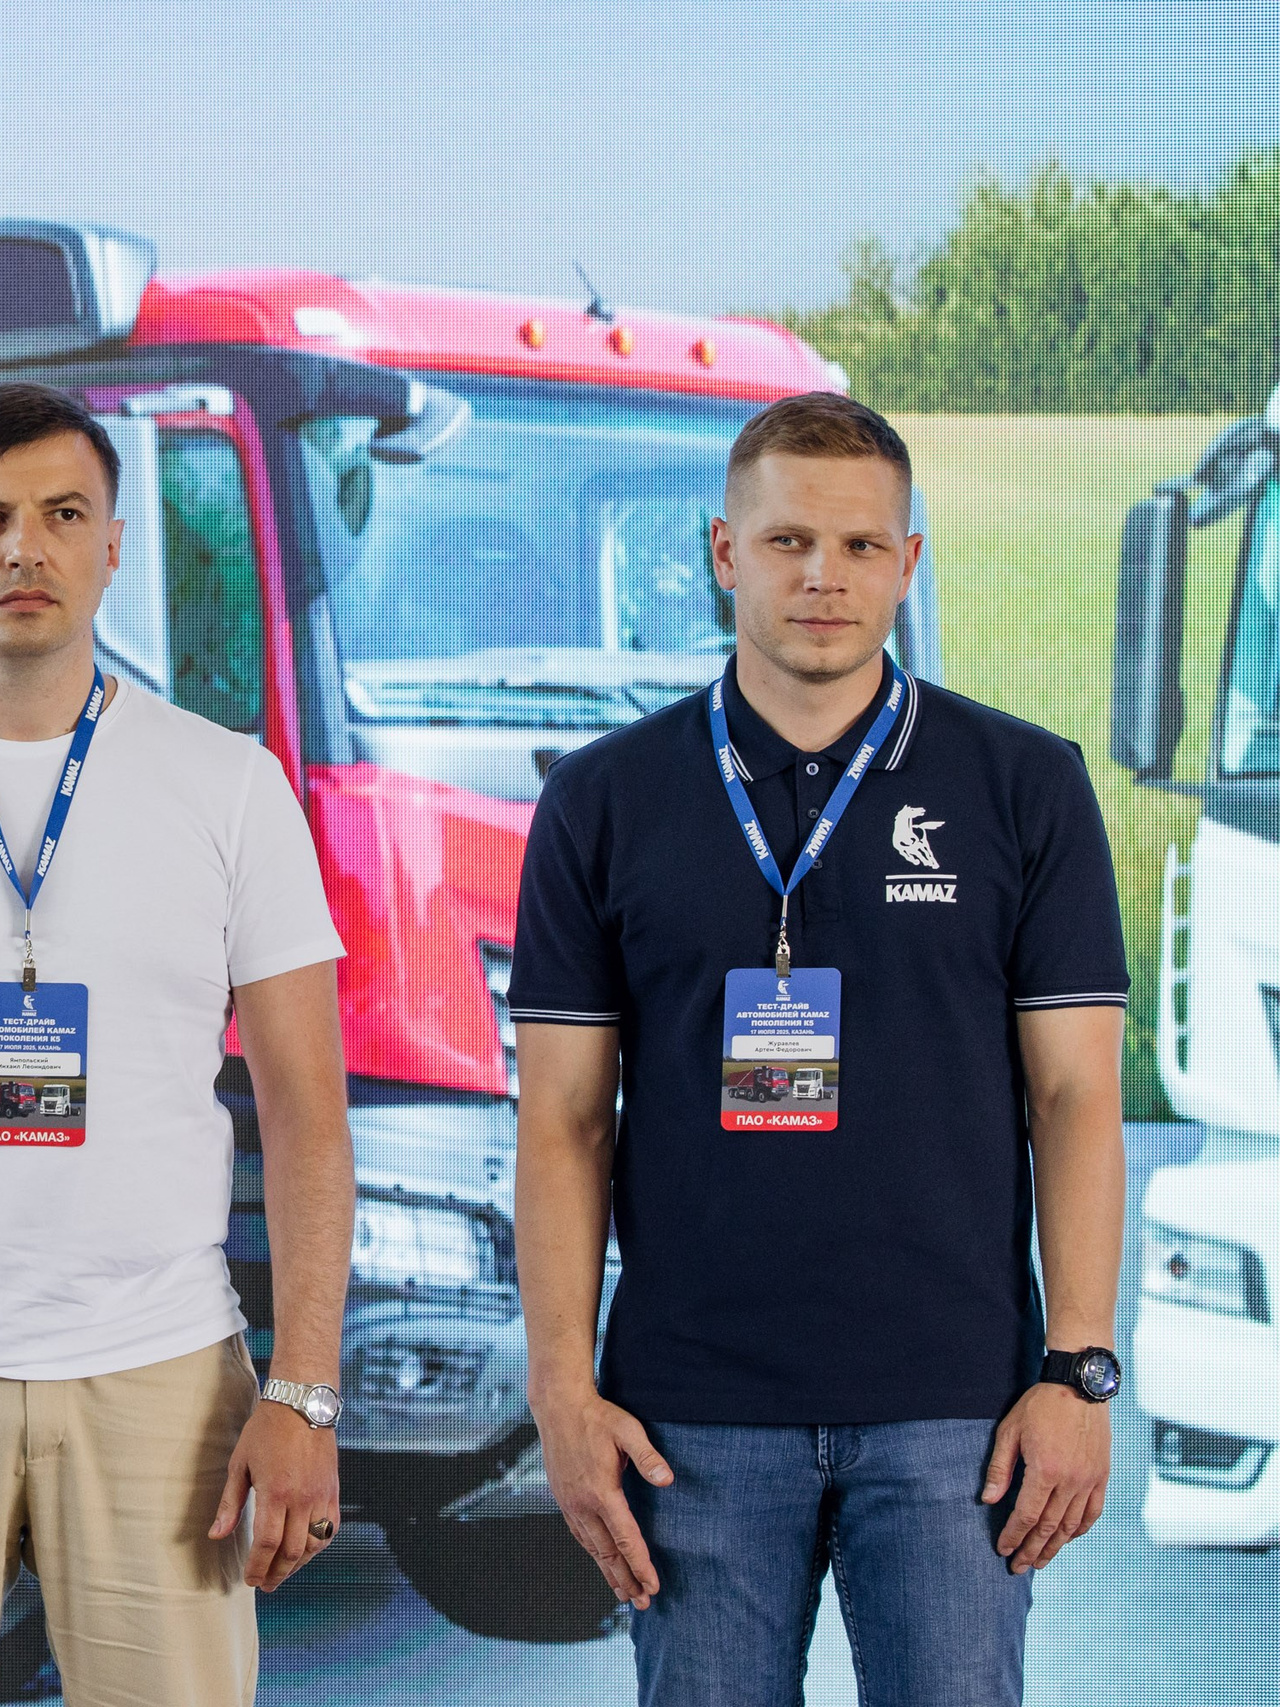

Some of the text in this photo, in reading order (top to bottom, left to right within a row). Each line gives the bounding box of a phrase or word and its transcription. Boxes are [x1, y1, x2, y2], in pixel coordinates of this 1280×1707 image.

[85, 685, 105, 722] KAMAZ
[887, 679, 903, 712] KAMAZ
[60, 758, 82, 797] KAMAZ
[718, 745, 736, 783] KAMAZ
[847, 743, 875, 780] KAMAZ
[744, 820, 769, 860] KAMAZ
[805, 818, 833, 858] KAMAZ
[36, 836, 56, 877] KAMAZ
[885, 883, 957, 903] KAMAZ
[3, 1018, 56, 1026] ТЕСТ-ДРАЙВ
[757, 1002, 810, 1010] ТЕСТ-ДРАЙВ
[46, 1027, 76, 1035] KAMAZ
[751, 1019, 802, 1027] ПОКОЛЕНИЯ
[14, 1132, 70, 1142] «КАМАЗ»
[736, 1115, 823, 1126] ПАО «КАМАЗ»
